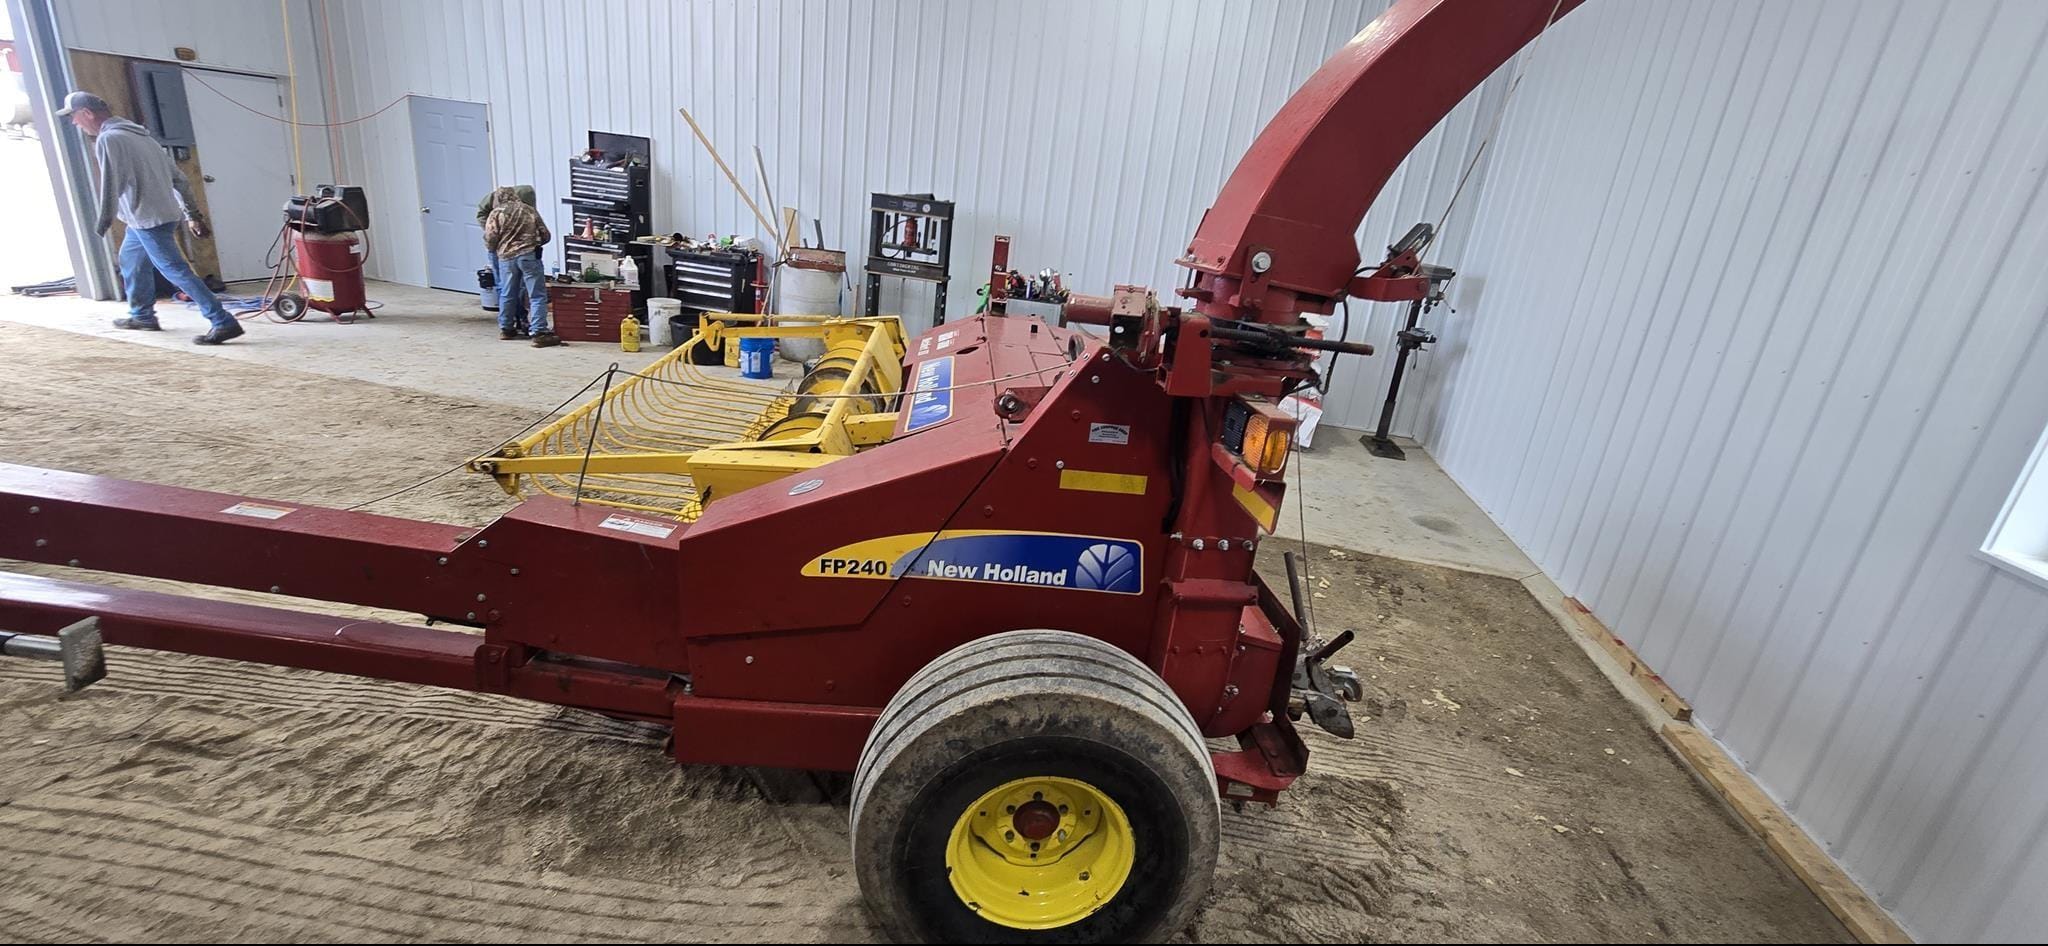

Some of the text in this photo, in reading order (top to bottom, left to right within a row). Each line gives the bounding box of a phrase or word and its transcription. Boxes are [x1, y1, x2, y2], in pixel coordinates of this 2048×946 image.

[914, 374, 940, 405] Hollnd
[820, 558, 887, 576] FP240
[927, 560, 1066, 586] New Holland
